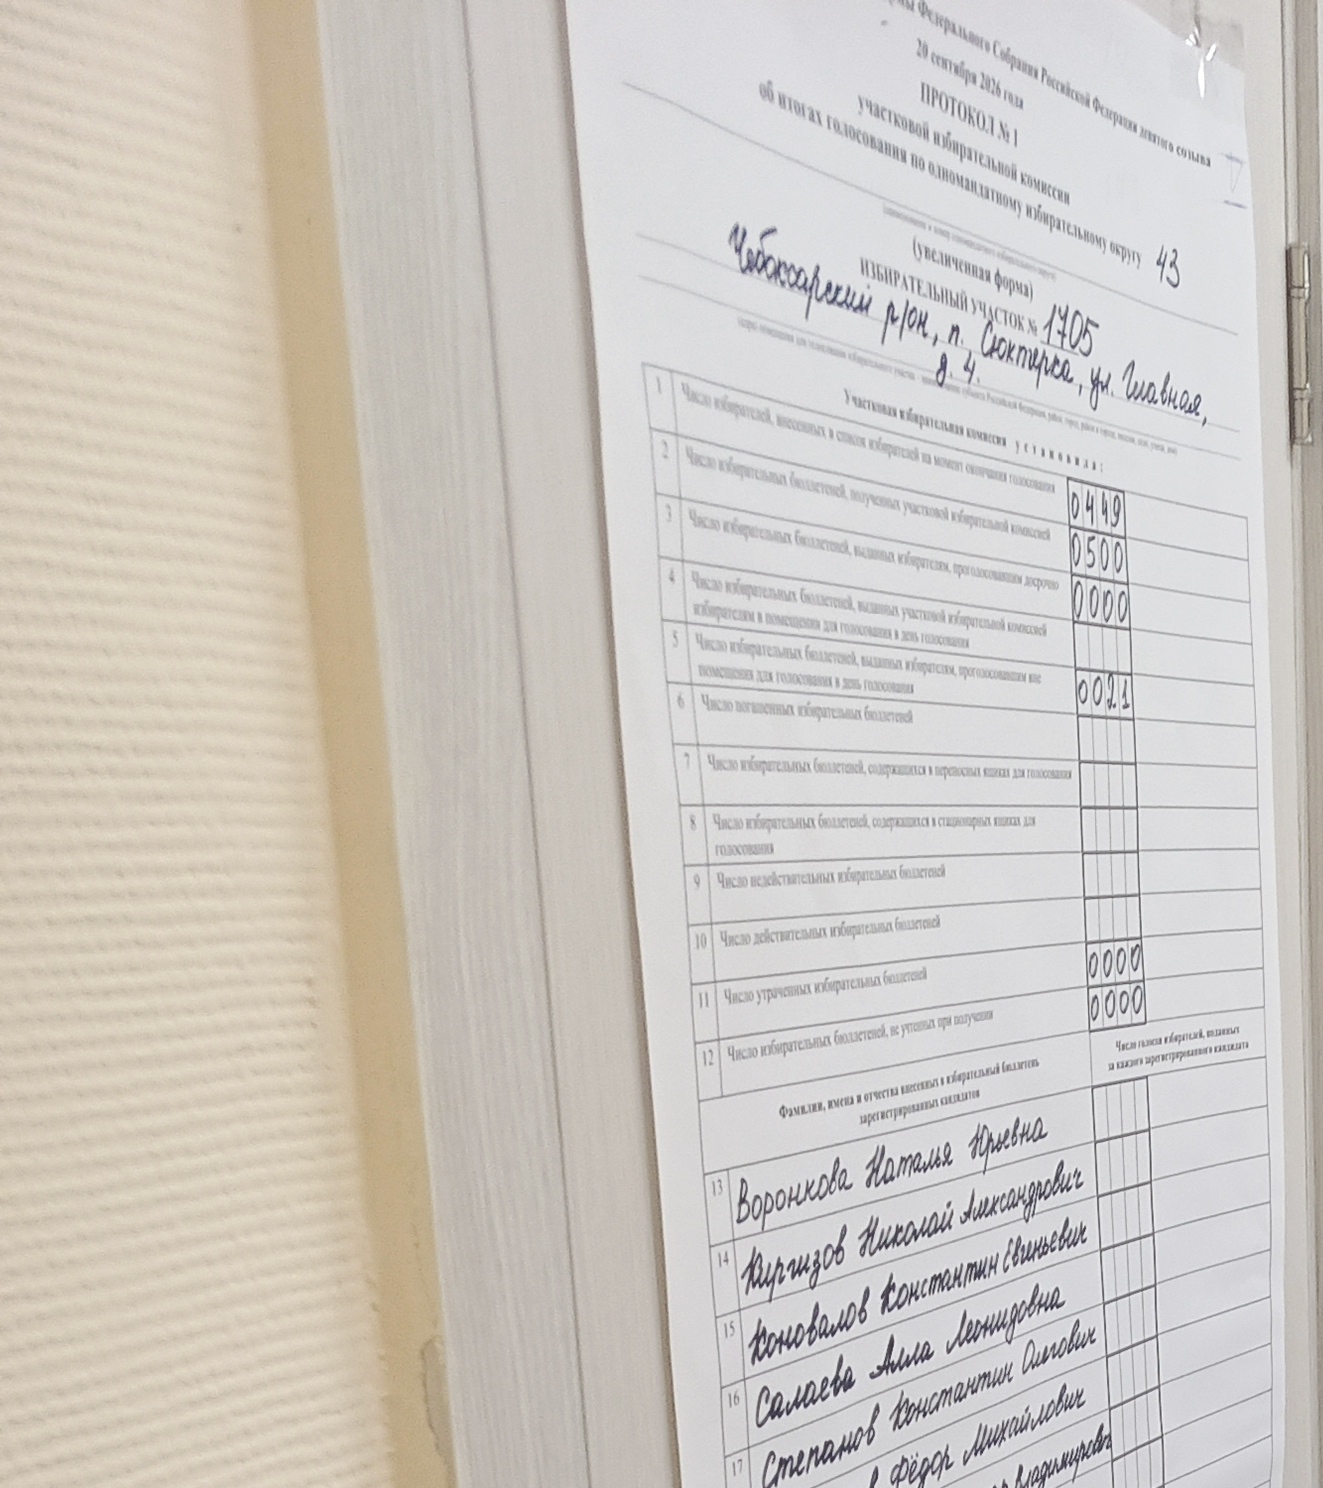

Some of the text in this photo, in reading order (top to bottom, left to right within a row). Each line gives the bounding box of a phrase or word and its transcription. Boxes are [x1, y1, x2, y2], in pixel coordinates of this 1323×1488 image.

[916, 37, 1023, 110] 20 сентября 2026 года
[920, 81, 994, 136] ПРОТОКОЛ
[758, 81, 774, 103] об
[777, 92, 822, 126] итогах
[826, 114, 907, 164] голосования
[910, 152, 925, 171] по
[927, 160, 1021, 215] одномандатному
[1025, 203, 1106, 253] избирательному
[1109, 240, 1141, 269] округу
[1157, 245, 1180, 288] 43
[857, 95, 1070, 205] участковой избирательной комиссии
[860, 257, 968, 312] ИЗБИРАТЕЛЬНЫЙ
[970, 297, 1024, 331] УЧАСТОК
[1043, 303, 1099, 357] 1705
[912, 238, 991, 283] (увеличенная
[993, 267, 1033, 301] форма)
[712, 1116, 1048, 1232] 13 Воронкова Наталья Юрьевна
[716, 1250, 730, 1268] 14
[858, 1200, 955, 1258] Николай
[960, 1160, 1083, 1222] Александрович
[723, 1320, 736, 1338] 15
[748, 1286, 867, 1365] Коновалов
[880, 1252, 999, 1315] Константин
[727, 1391, 740, 1409] 16
[869, 1333, 935, 1380] Алла
[946, 1285, 1066, 1355] Леонидовна
[731, 1459, 744, 1476] 17
[888, 1362, 1014, 1432] Константин
[1022, 1318, 1096, 1375] Олегович
[963, 1382, 1086, 1466] Михайлович
